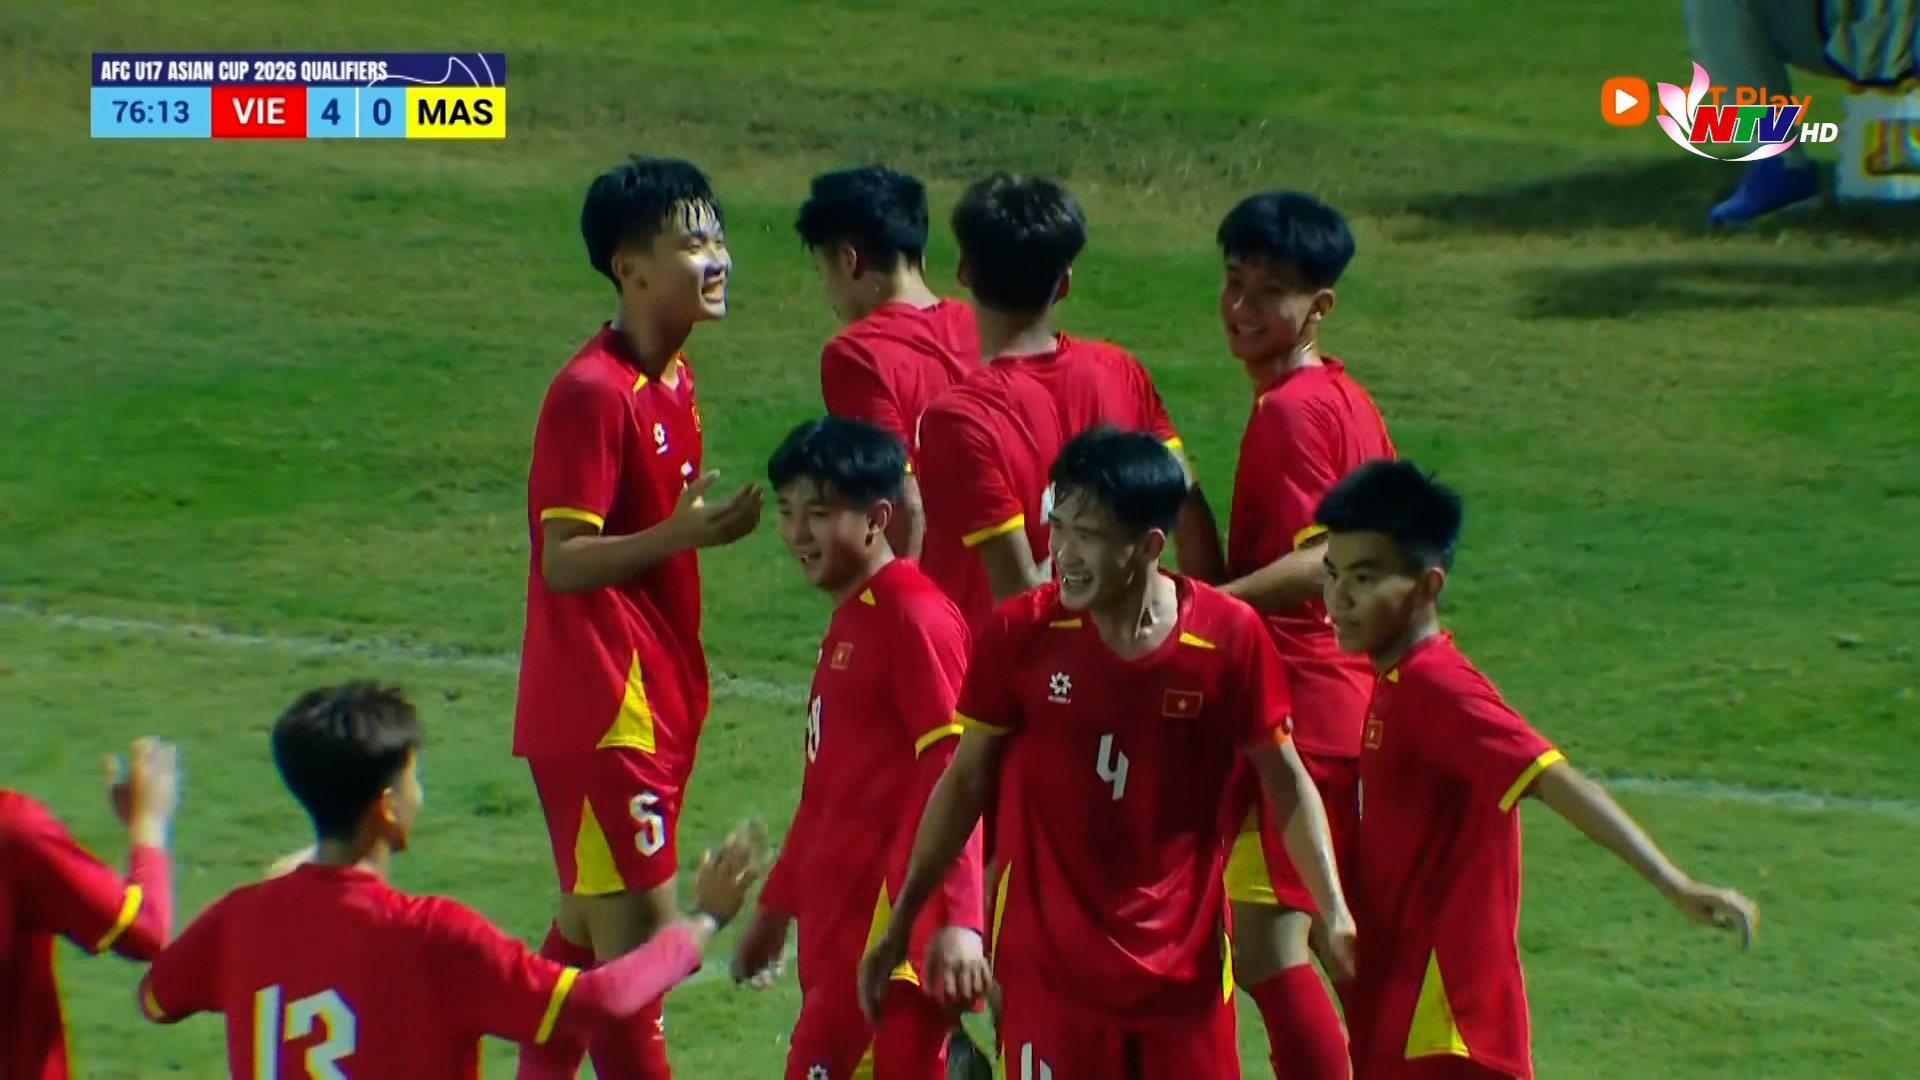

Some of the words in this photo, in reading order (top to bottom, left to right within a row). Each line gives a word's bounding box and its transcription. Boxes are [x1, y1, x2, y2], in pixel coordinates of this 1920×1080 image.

[1096, 732, 1130, 801] 4
[629, 790, 666, 858] 5
[253, 983, 358, 1080] 13
